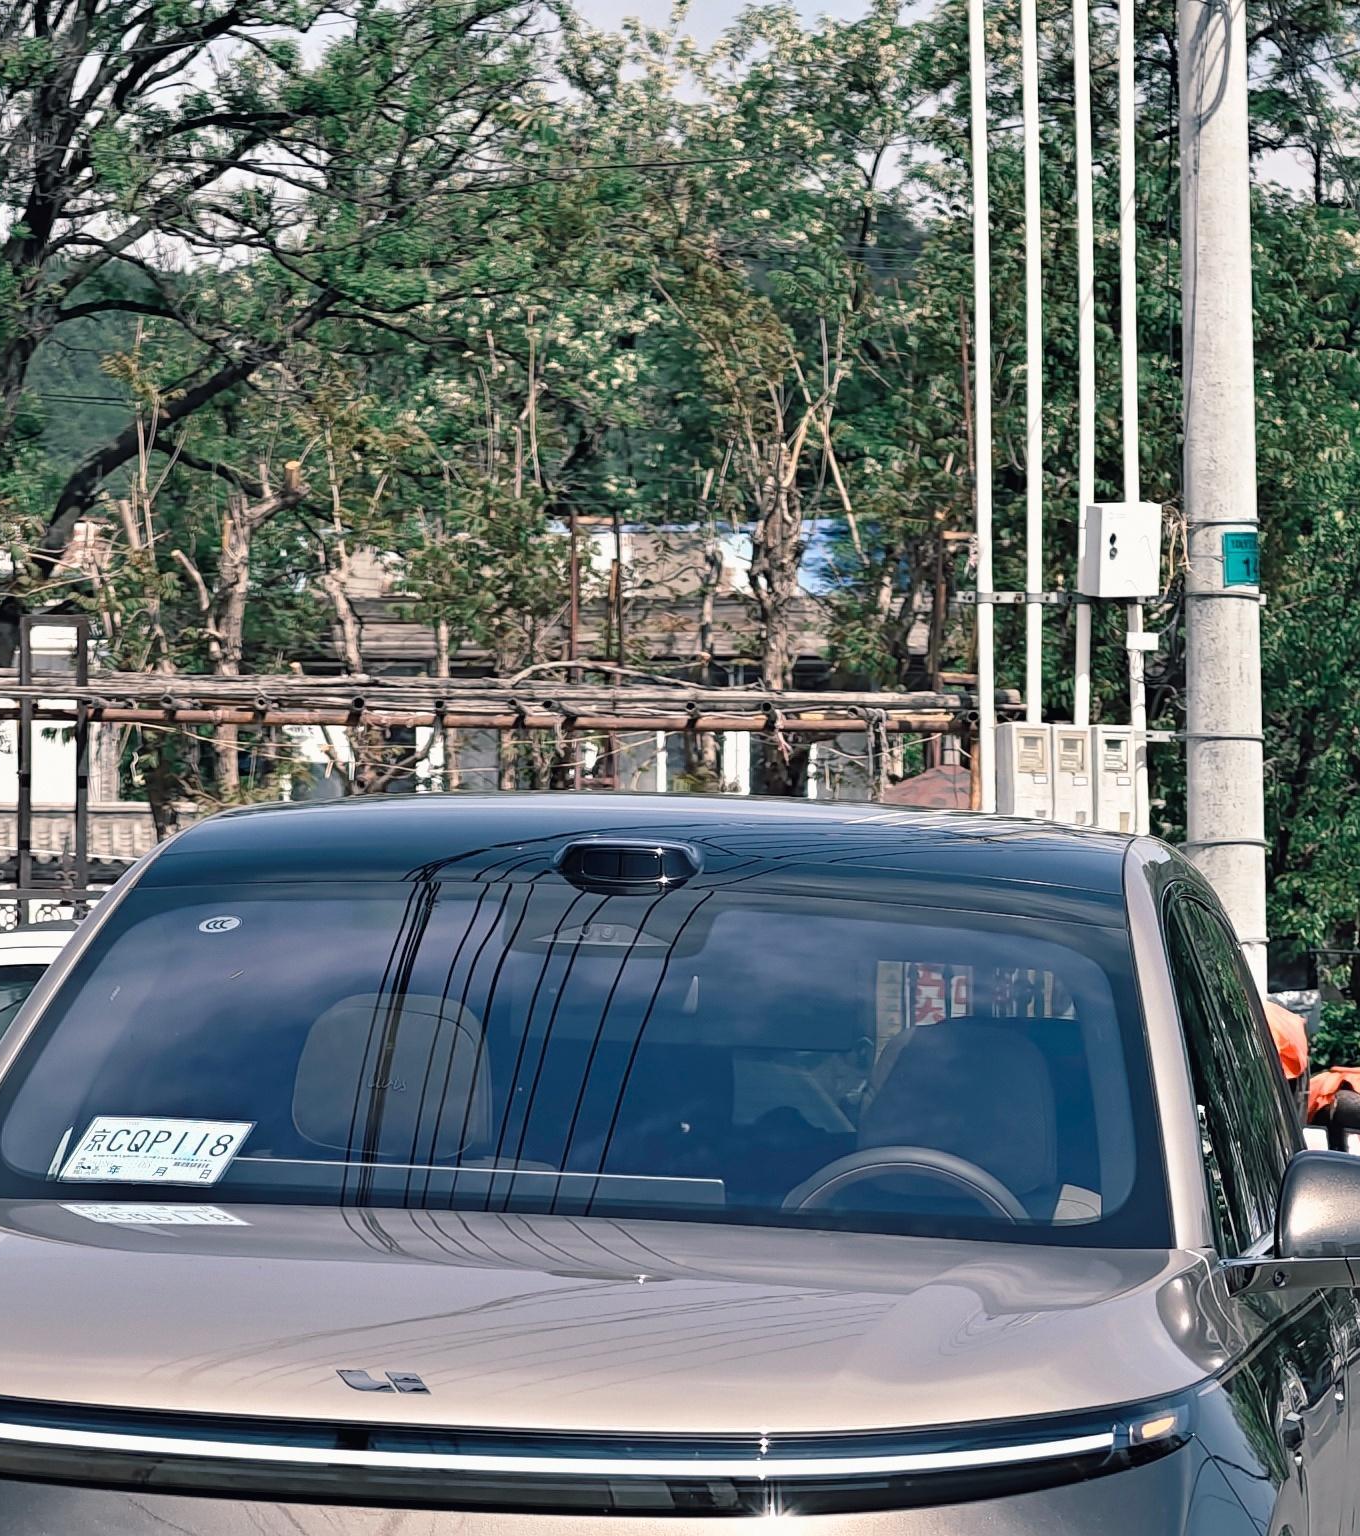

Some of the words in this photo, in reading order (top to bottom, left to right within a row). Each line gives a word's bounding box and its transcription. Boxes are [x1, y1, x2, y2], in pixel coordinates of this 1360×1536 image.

[84, 1128, 235, 1158] 京CQP118
[152, 1166, 168, 1177] 月
[199, 1169, 212, 1180] 日
